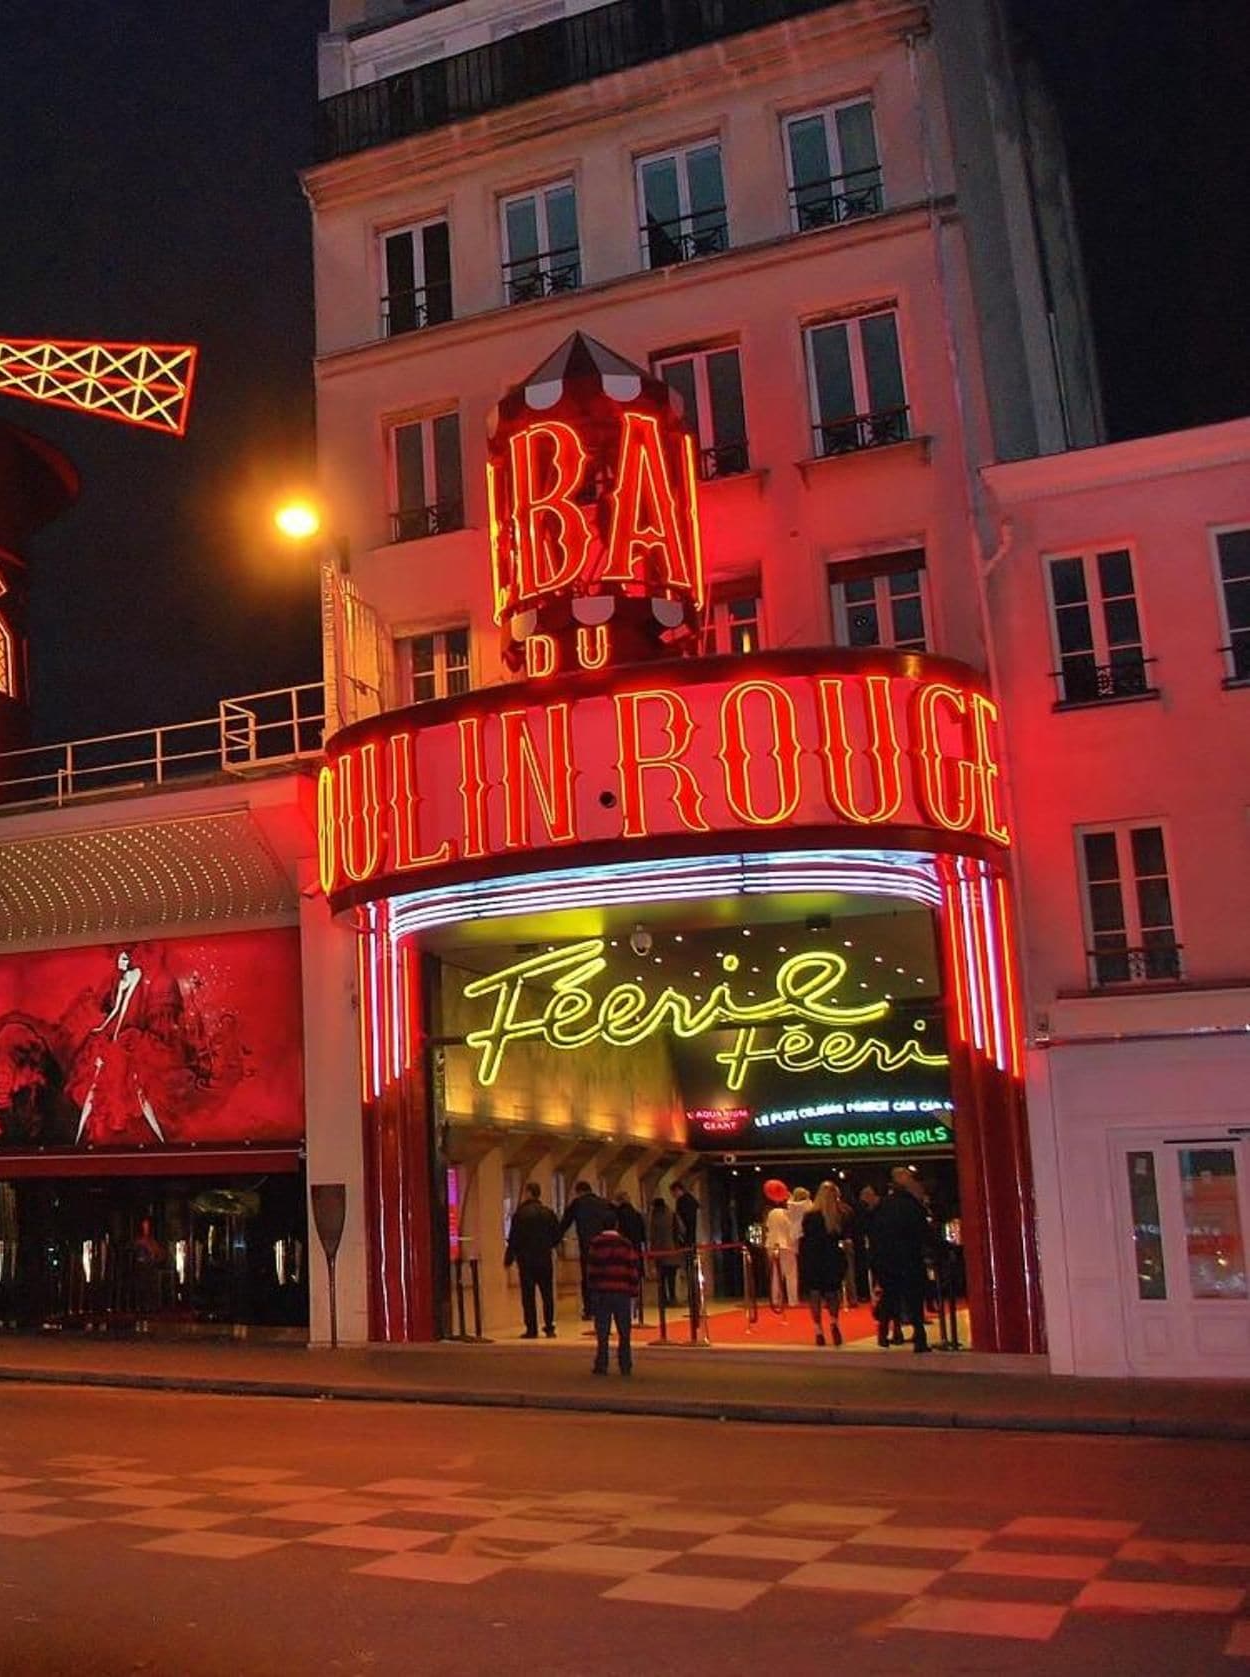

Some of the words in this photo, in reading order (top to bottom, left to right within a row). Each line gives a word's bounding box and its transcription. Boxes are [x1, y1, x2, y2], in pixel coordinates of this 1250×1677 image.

[525, 625, 610, 678] DU
[613, 676, 1011, 846] ROUGE
[463, 938, 892, 1088] Féerie
[803, 1131, 833, 1146] LES
[837, 1129, 897, 1147] DORISS
[899, 1126, 948, 1146] GIRLS
